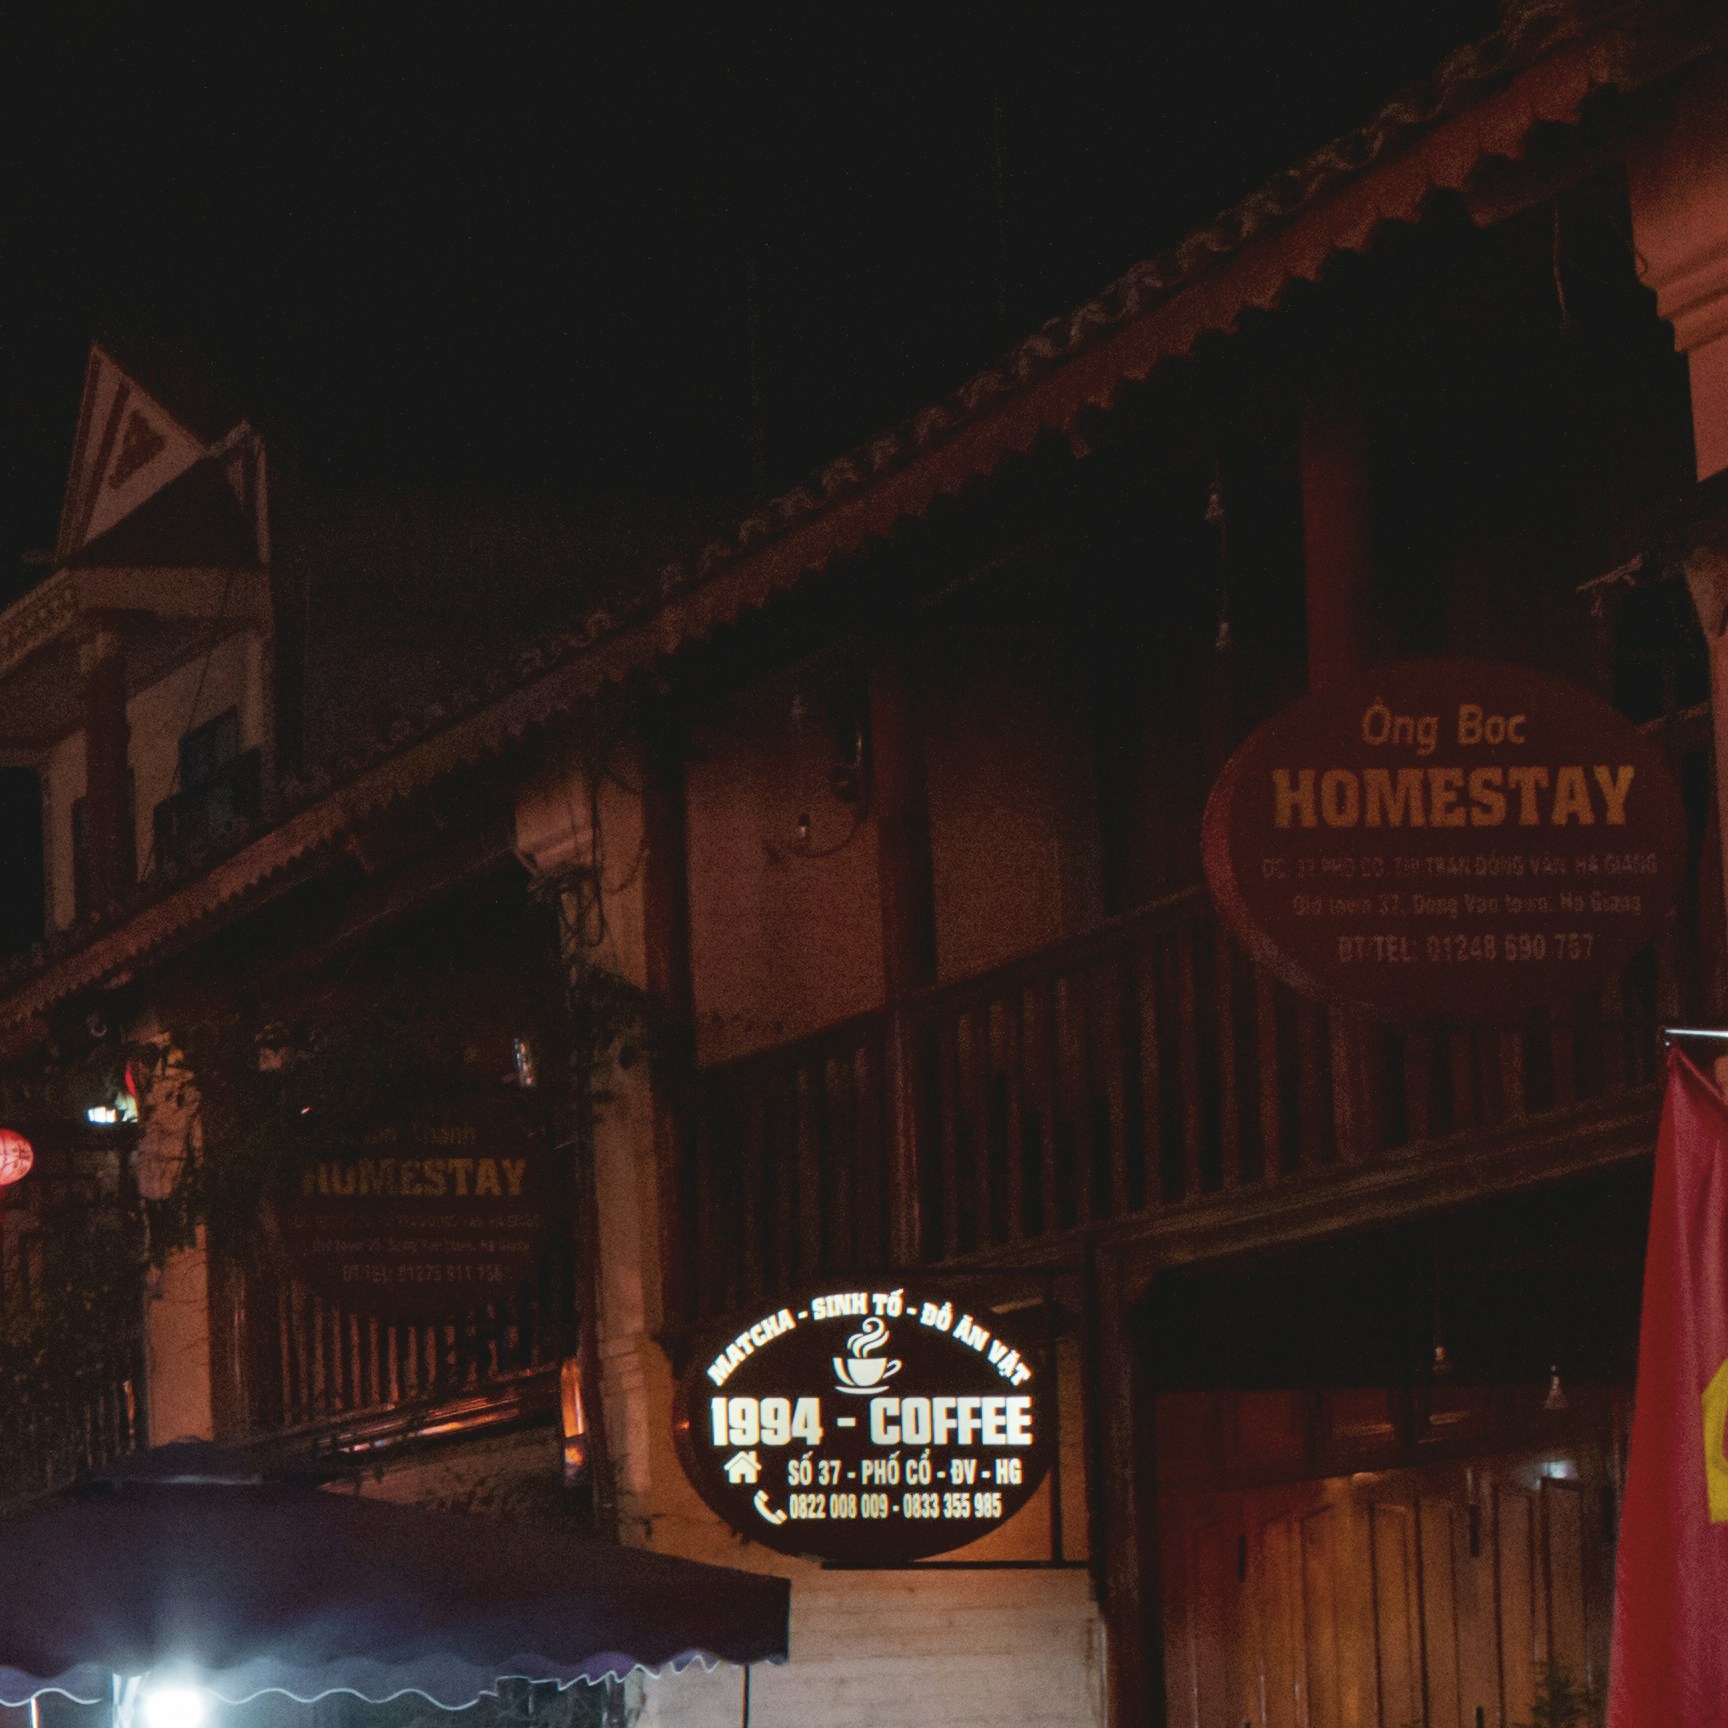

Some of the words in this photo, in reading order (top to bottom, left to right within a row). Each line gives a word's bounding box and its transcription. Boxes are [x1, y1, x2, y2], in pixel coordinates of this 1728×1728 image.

[1271, 763, 1636, 830] HOMESTAY
[706, 1307, 797, 1388] MATCHA
[811, 1291, 869, 1322] SINH
[872, 1287, 905, 1317] TỐ
[919, 1300, 954, 1331] ĐỒ
[710, 1396, 824, 1447] 1994
[869, 1396, 1034, 1447] COFFEE
[787, 1450, 814, 1486] SỐ
[818, 1459, 841, 1486] 37
[860, 1450, 901, 1486] PHỐ
[995, 1458, 1023, 1485] HG
[788, 1493, 827, 1520] 0822
[829, 1493, 858, 1519] 008
[860, 1492, 889, 1519] 009
[903, 1492, 940, 1520] 0833
[942, 1492, 971, 1519] 355
[973, 1491, 1003, 1519] 985
